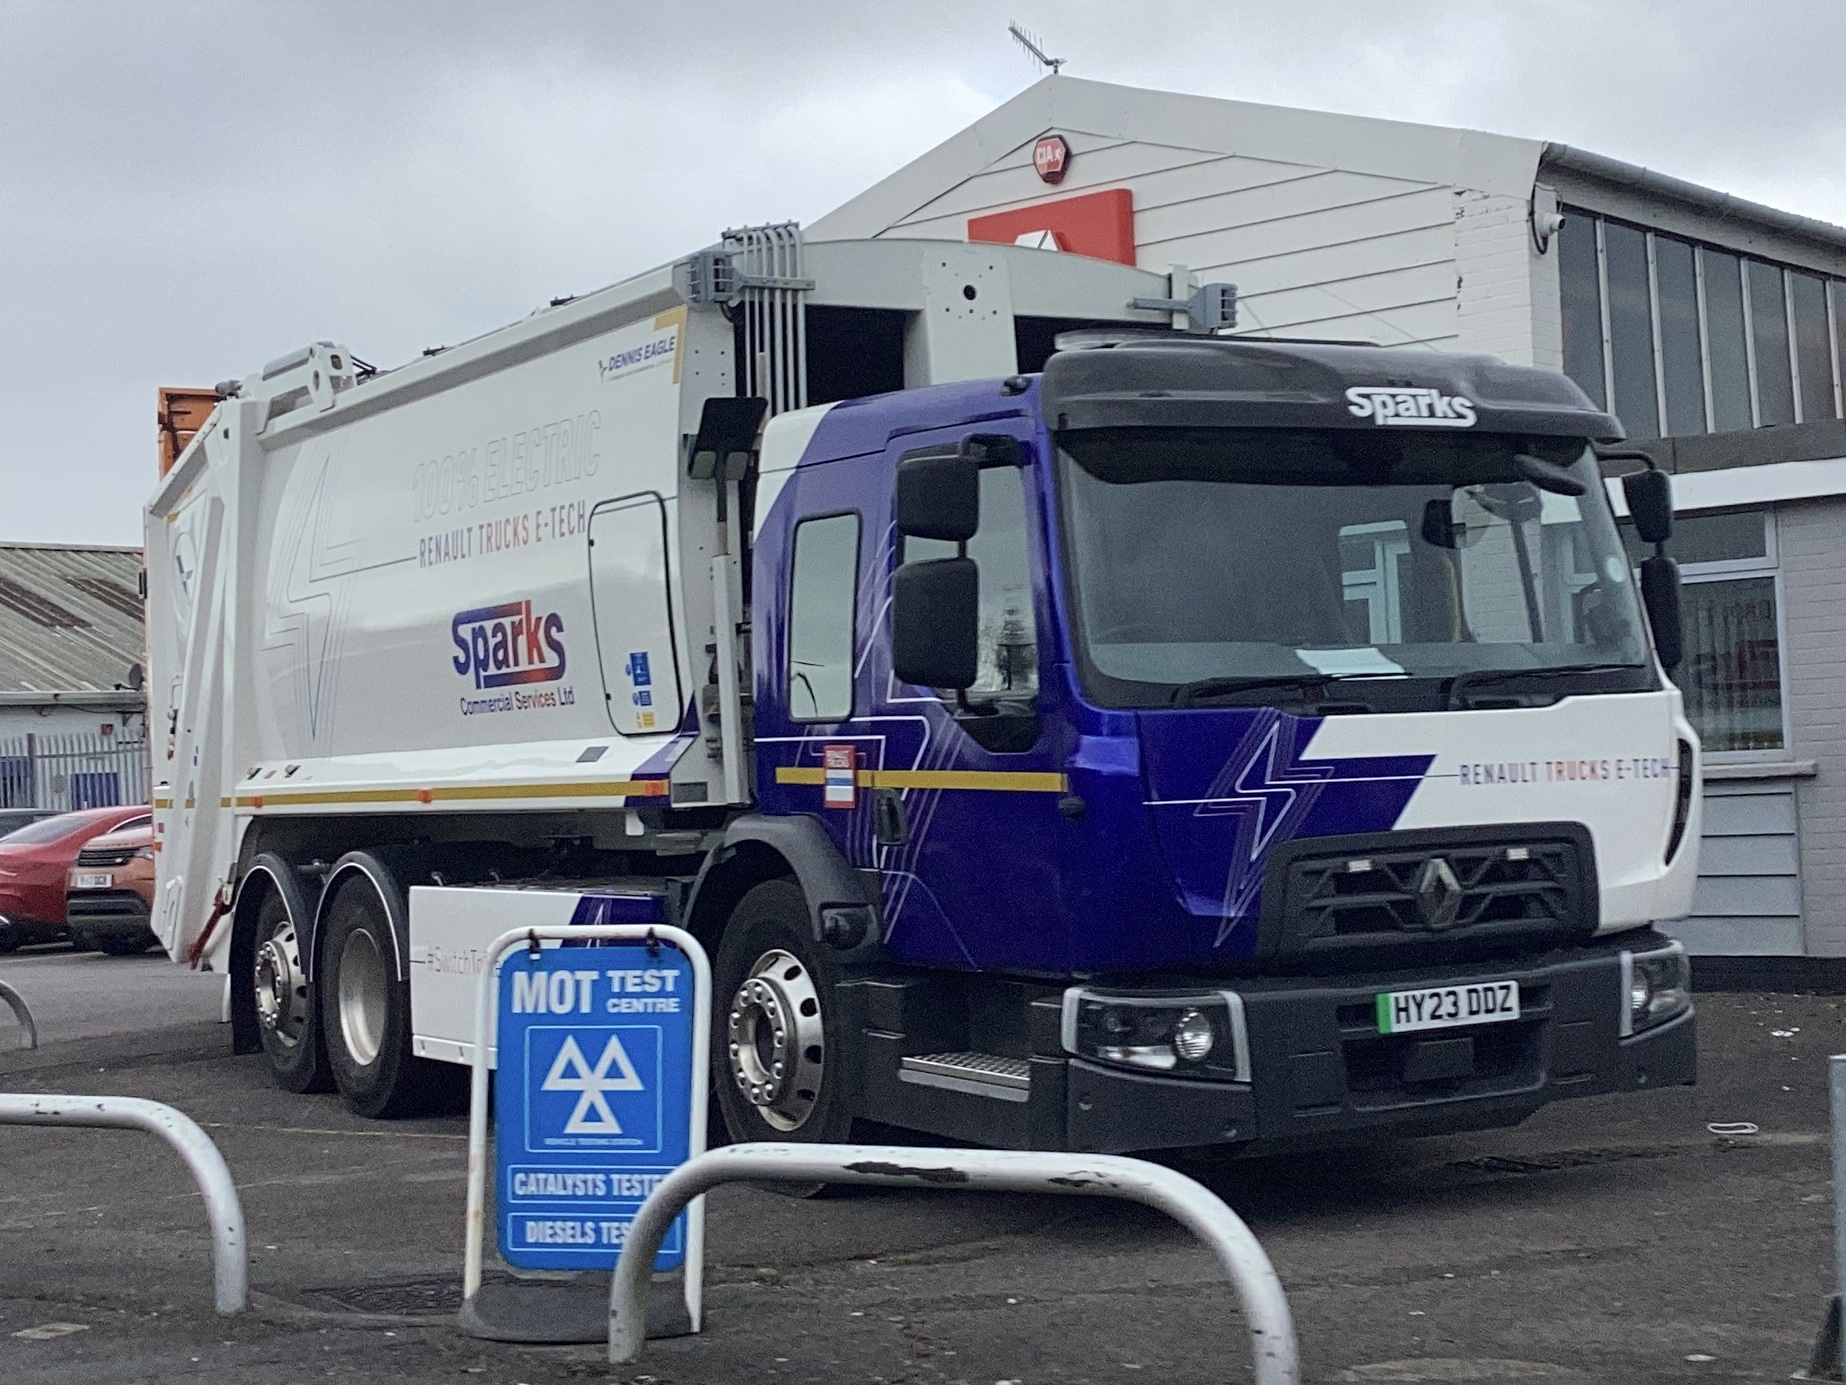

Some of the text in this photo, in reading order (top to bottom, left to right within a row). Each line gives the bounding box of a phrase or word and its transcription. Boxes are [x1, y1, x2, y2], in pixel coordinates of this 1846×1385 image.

[608, 335, 675, 371] DENNIS EAGLE
[1345, 386, 1478, 428] Sparks
[412, 409, 601, 524] 100% ELECTRIC
[419, 499, 586, 568] RENAULT TRUCKS E-TECH
[452, 599, 566, 690] Sparks
[460, 686, 575, 716] Commercial Services Ltd
[1459, 758, 1670, 785] RENAULT TRUCKS E-TECH
[511, 969, 681, 1014] MOT TEST
[606, 997, 681, 1014] CENTRE
[1394, 984, 1513, 1024] HY23 DDZ
[513, 1172, 668, 1196] CATALYSTS TEST
[524, 1220, 632, 1245] DIESELS TES
